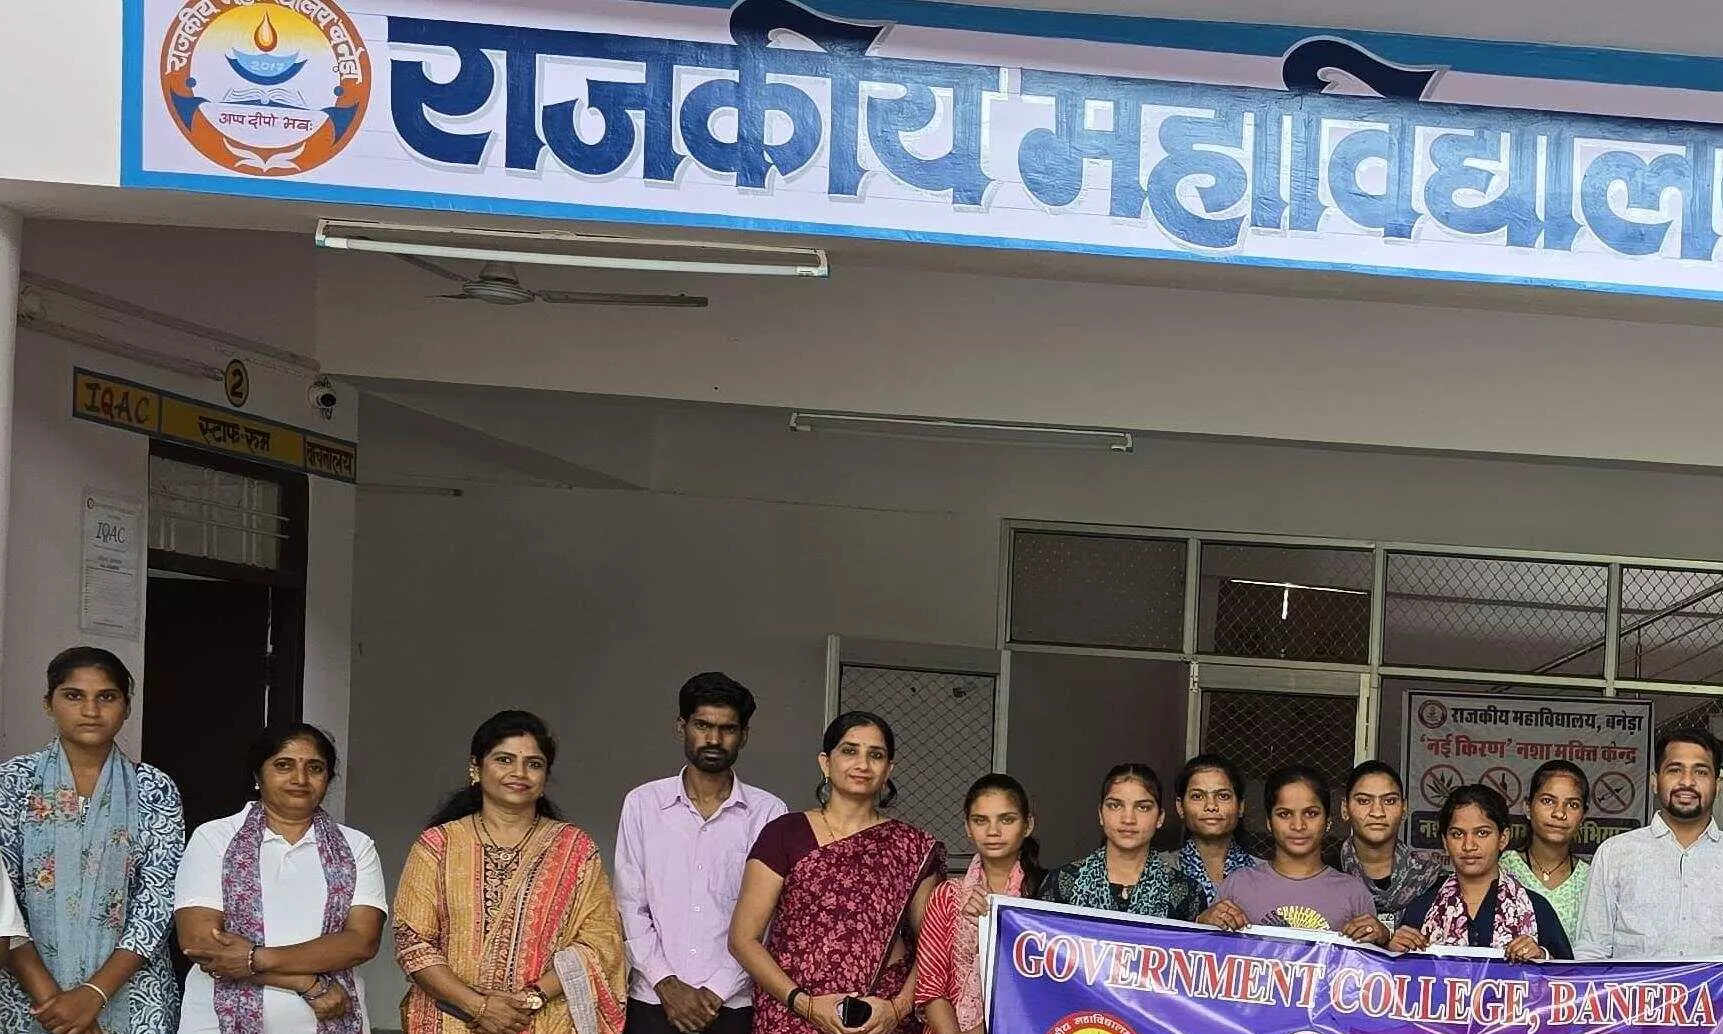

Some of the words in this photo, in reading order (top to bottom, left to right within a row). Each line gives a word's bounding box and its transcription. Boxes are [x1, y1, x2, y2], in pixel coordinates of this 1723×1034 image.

[250, 61, 285, 72] 2017
[387, 0, 1020, 207] राजकीय
[229, 368, 245, 399] 2
[84, 381, 151, 425] IQAC
[95, 521, 127, 544] IQAC
[1450, 704, 1509, 726] राजकीय
[1605, 709, 1644, 736] बनेड़ा
[1516, 742, 1551, 760] नशा
[1012, 928, 1321, 1011] GOVERNMENT
[1330, 966, 1541, 1032] COLLEGE,
[1547, 977, 1718, 1029] BANERA
